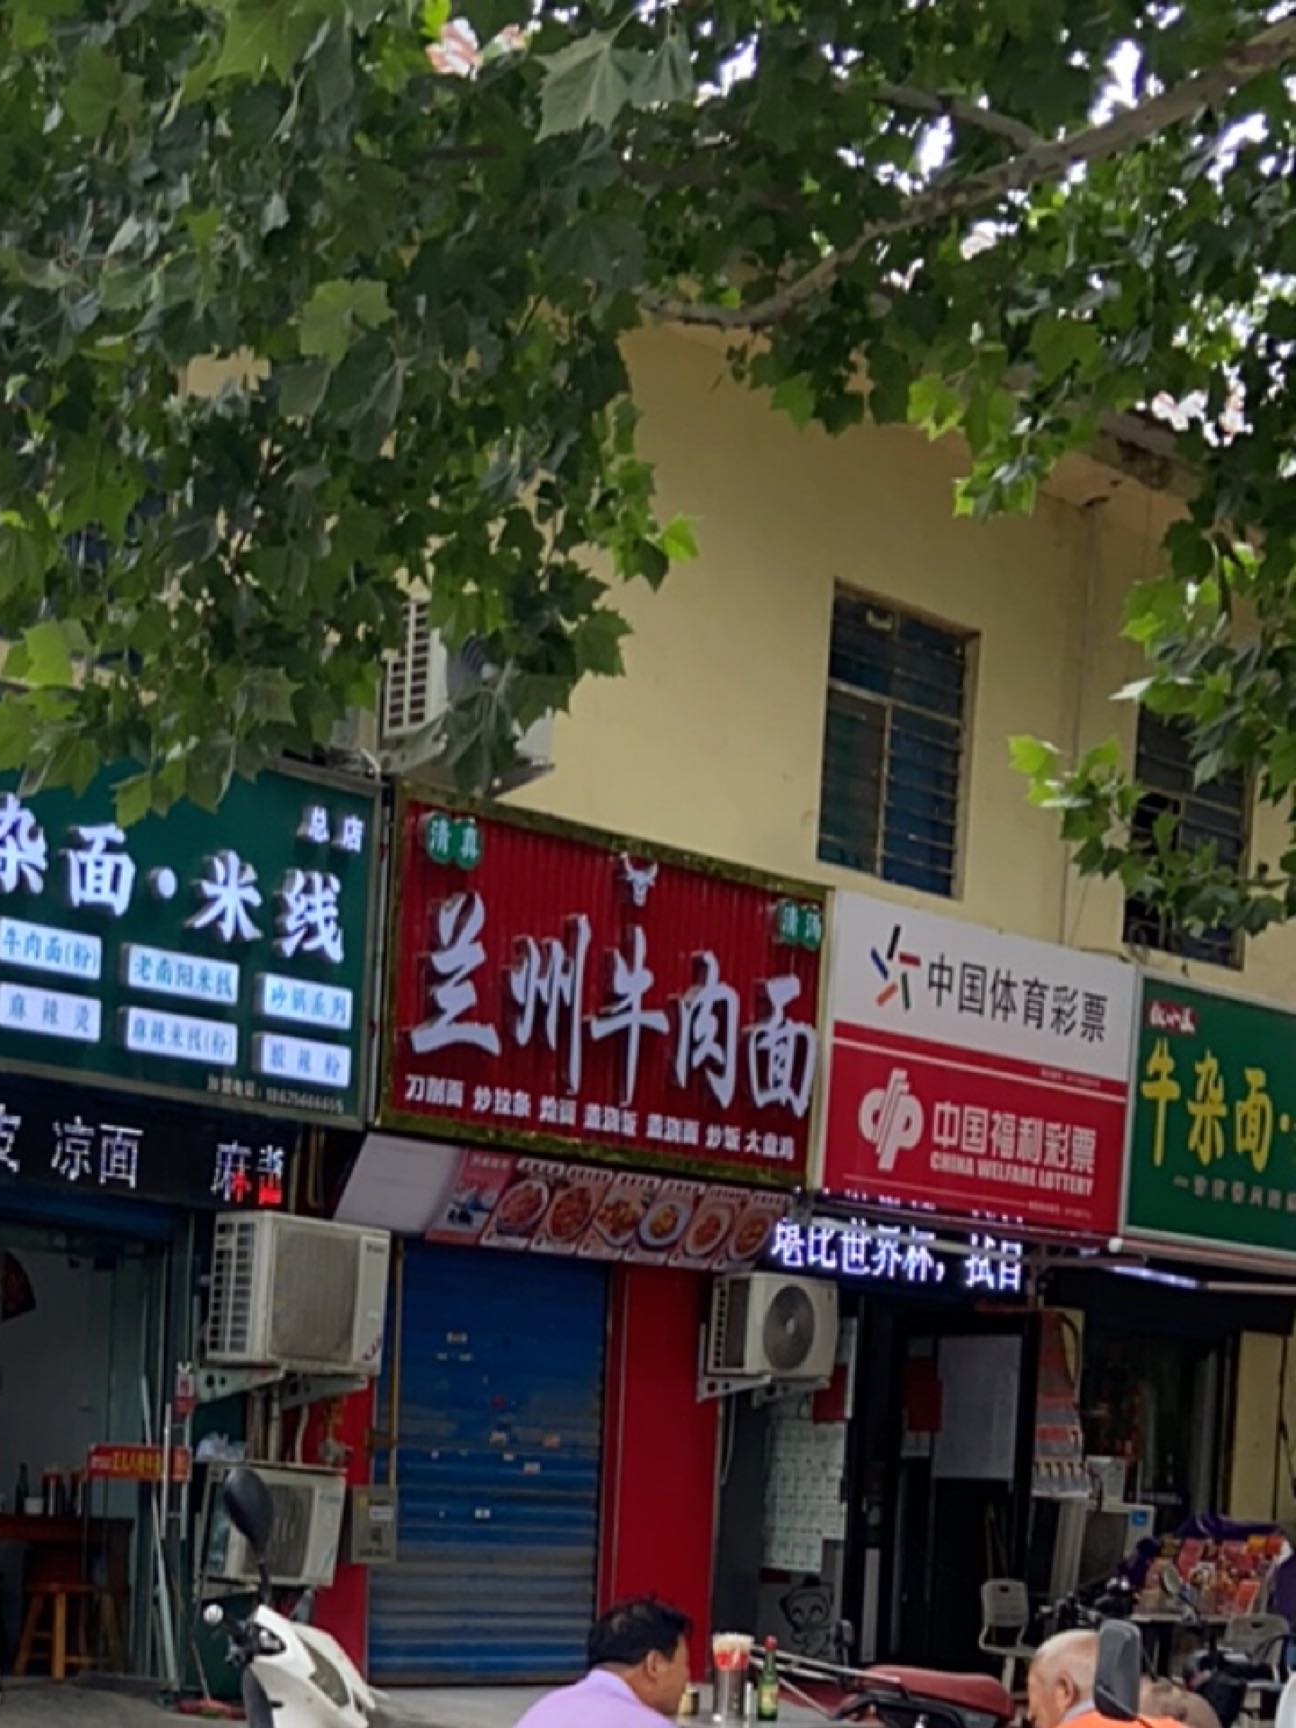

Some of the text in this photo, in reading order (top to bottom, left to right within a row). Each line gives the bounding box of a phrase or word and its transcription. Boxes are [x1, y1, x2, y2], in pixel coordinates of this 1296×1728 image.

[410, 892, 817, 1118] 兰州牛肉面
[927, 954, 1109, 1043] 中国体育彩票
[51, 1116, 144, 1189] 凉面
[930, 1150, 1094, 1197] CHINA WELFARE LOTTERY
[933, 1101, 1097, 1175] 中国福利彩票
